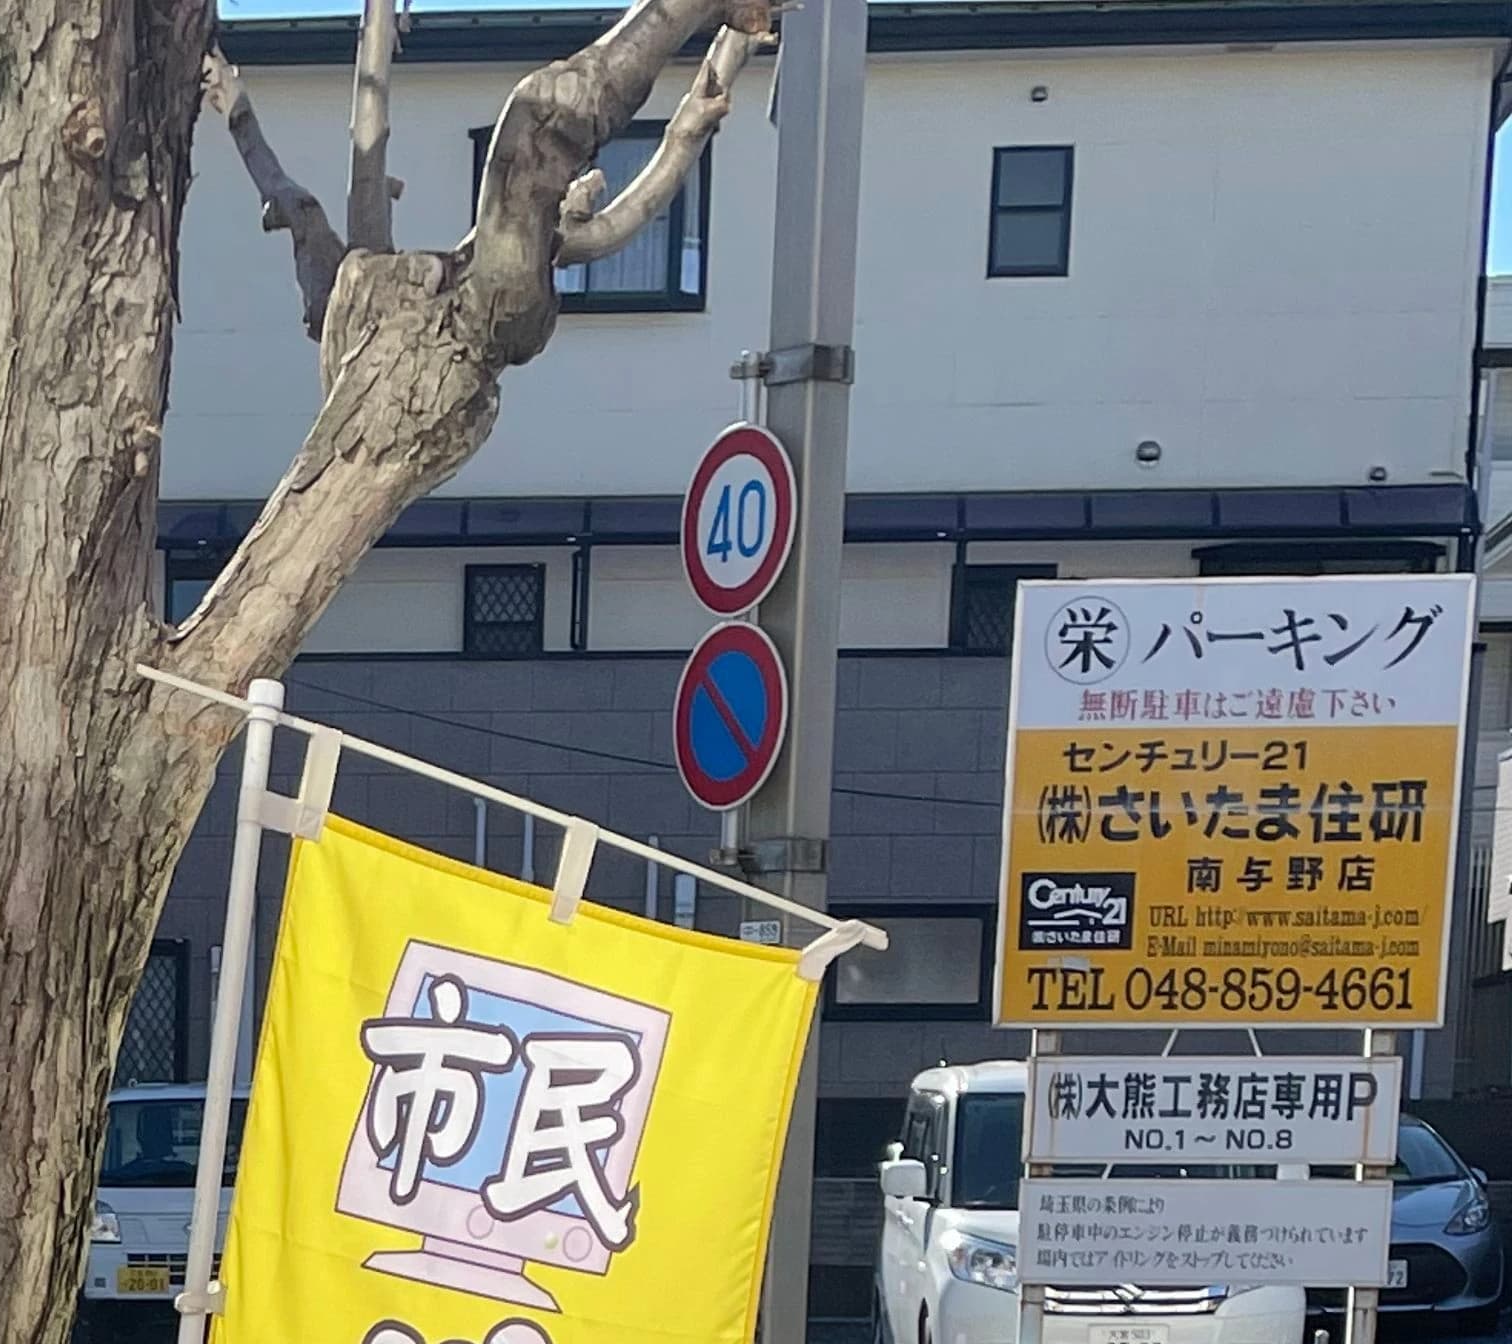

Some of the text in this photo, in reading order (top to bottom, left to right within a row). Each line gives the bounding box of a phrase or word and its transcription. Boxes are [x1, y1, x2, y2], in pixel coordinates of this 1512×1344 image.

[707, 479, 768, 563] 40
[1076, 686, 1397, 721] 無断駐車はご遠慮下さい
[1063, 740, 1309, 775] センチュリー21
[1187, 856, 1375, 894] 南与野店
[1149, 905, 1188, 928] URL
[1027, 967, 1413, 1011] TEL 048-859-4661
[360, 973, 642, 1251] 市民
